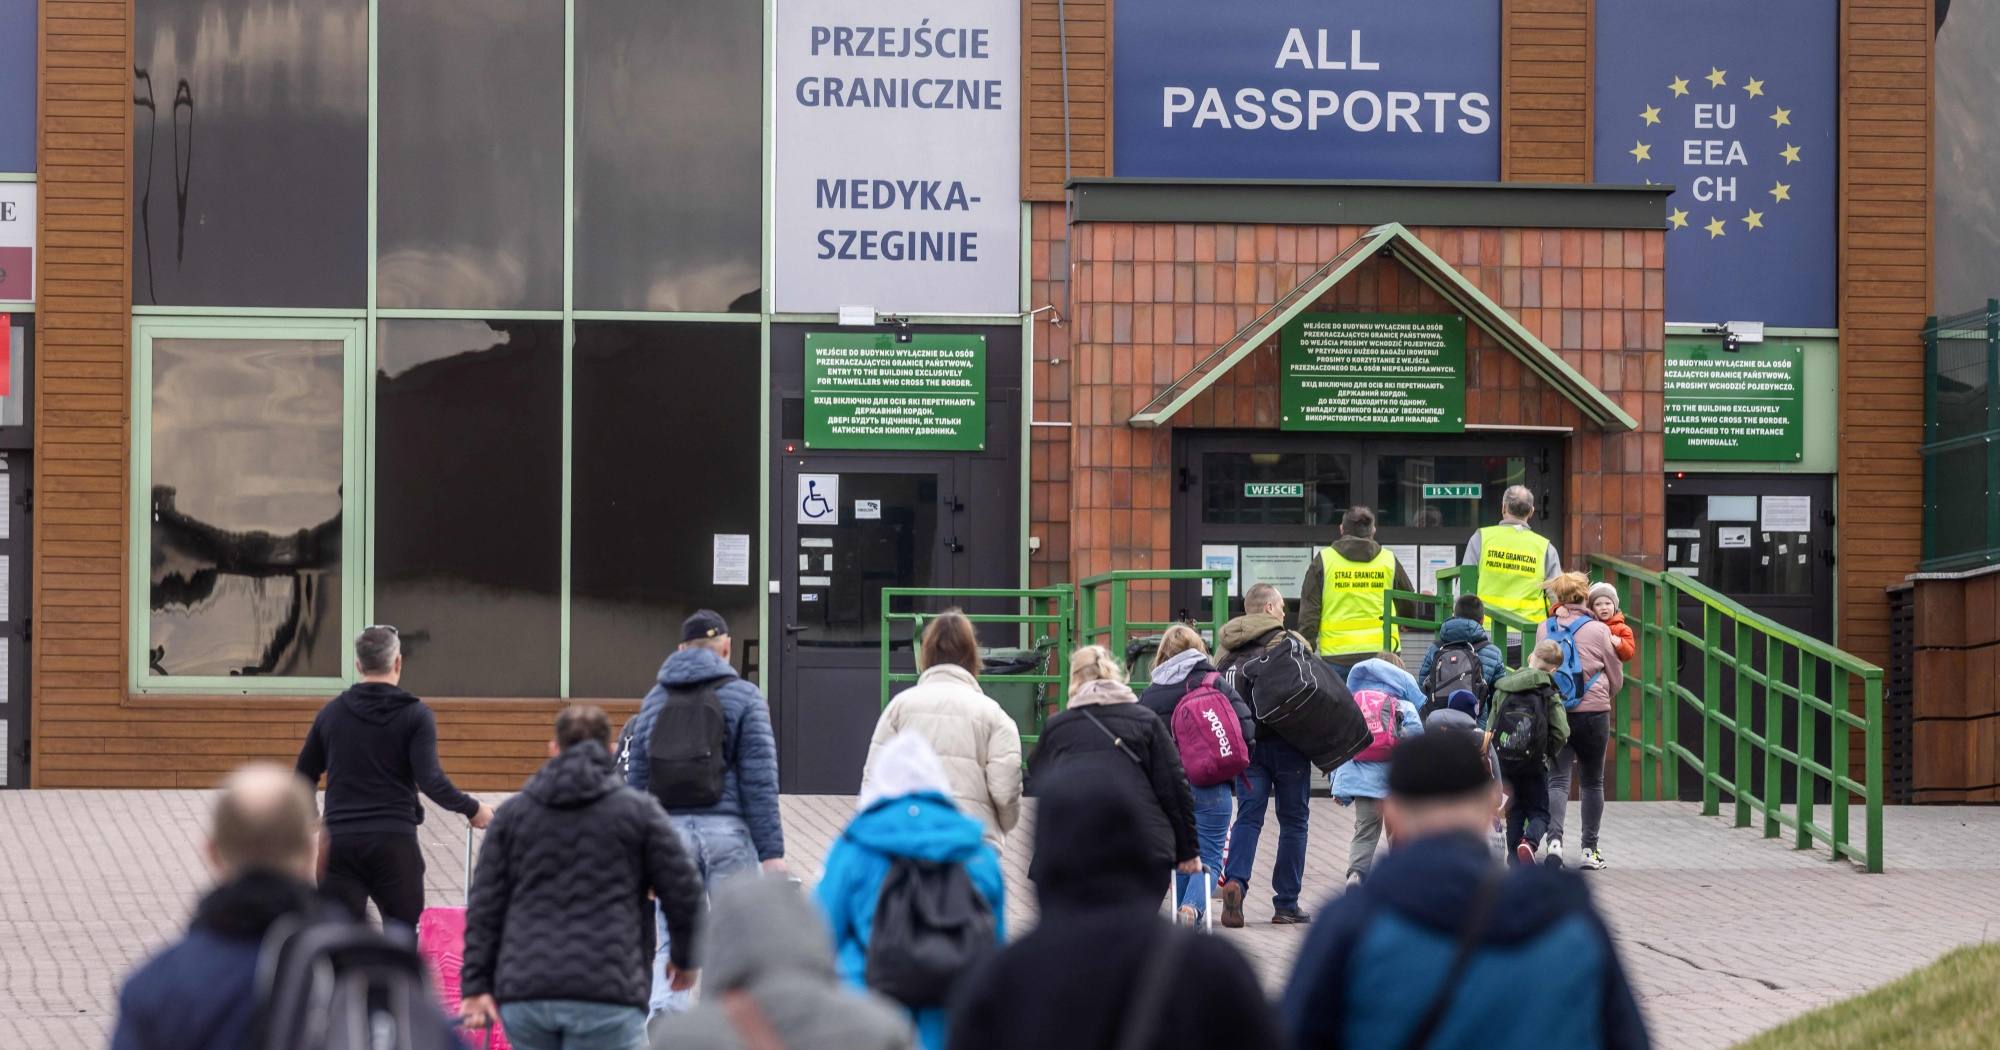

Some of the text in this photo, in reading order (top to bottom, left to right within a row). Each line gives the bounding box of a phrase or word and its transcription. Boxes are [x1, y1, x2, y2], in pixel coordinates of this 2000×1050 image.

[811, 18, 988, 58] PRZEJŚCIE
[1274, 28, 1380, 70] ALL
[796, 76, 1002, 110] GRANICZNE
[1163, 86, 1491, 134] PASSPORTS
[1694, 104, 1736, 129] EU
[1684, 140, 1748, 165] EEA
[1692, 176, 1736, 202] CH
[816, 178, 981, 211] MEDYKA-
[817, 230, 978, 262] SZEGINIE
[1303, 322, 1331, 330] WEJŚCIE
[1399, 331, 1442, 340] PAŃSTWOWĄ.
[1369, 339, 1402, 347] WCHODZIĆ
[816, 348, 847, 356] WEJŚCIE
[896, 351, 938, 359] WYŁĄCZNIE
[955, 349, 974, 358] OSÓB
[892, 360, 924, 368] GRANICĘ
[925, 359, 973, 368] PAŃSTWOWĄ.
[1772, 360, 1792, 368] OSÓB
[1743, 371, 1791, 380] PAŃSTWOWĄ.
[1709, 382, 1746, 390] WCHODZIĆ
[1337, 390, 1379, 399] ДЕРЖАВНИЙ
[855, 407, 934, 417] ДЕРЖАВНИЙ КОРДОН.
[828, 418, 850, 426] ДВЕРІ
[851, 418, 879, 426] БУДУТЬ
[880, 418, 922, 426] ВІДЧИНЕНІ,
[1372, 416, 1388, 424] ВХІД
[1390, 416, 1404, 424] ДЛЯ
[1405, 417, 1440, 425] ІНВАЛІДІВ.
[915, 428, 957, 436] ДЗВОНИКА.
[1506, 552, 1536, 564] GRANICZNA
[1202, 708, 1232, 757] Reebok
